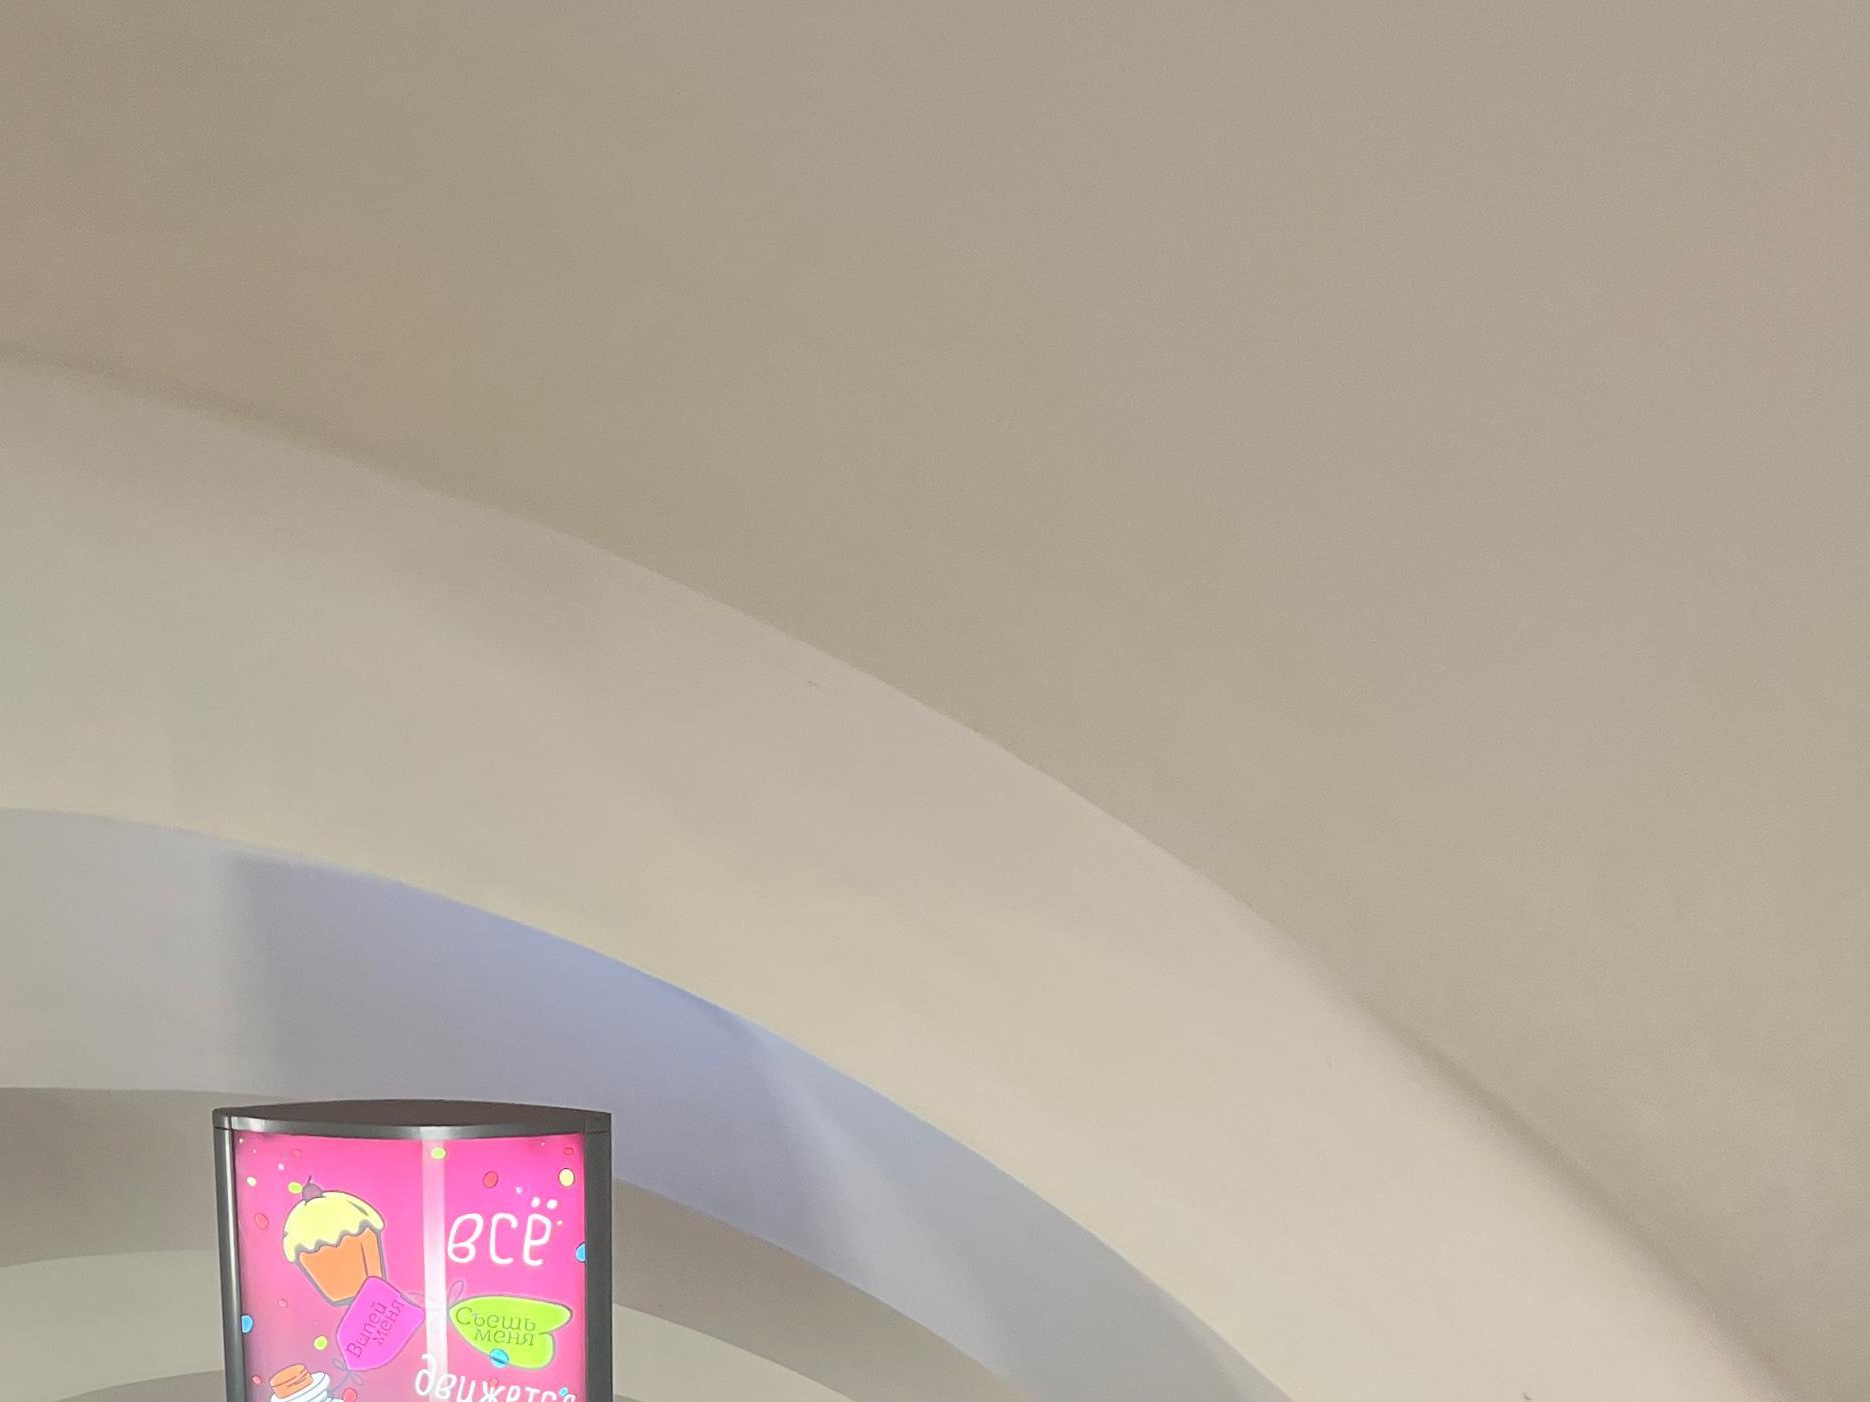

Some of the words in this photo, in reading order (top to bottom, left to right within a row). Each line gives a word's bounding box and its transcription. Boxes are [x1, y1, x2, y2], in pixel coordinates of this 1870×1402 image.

[346, 1302, 388, 1359] Выпей
[455, 1306, 536, 1332] Съешь
[474, 1329, 535, 1346] меня
